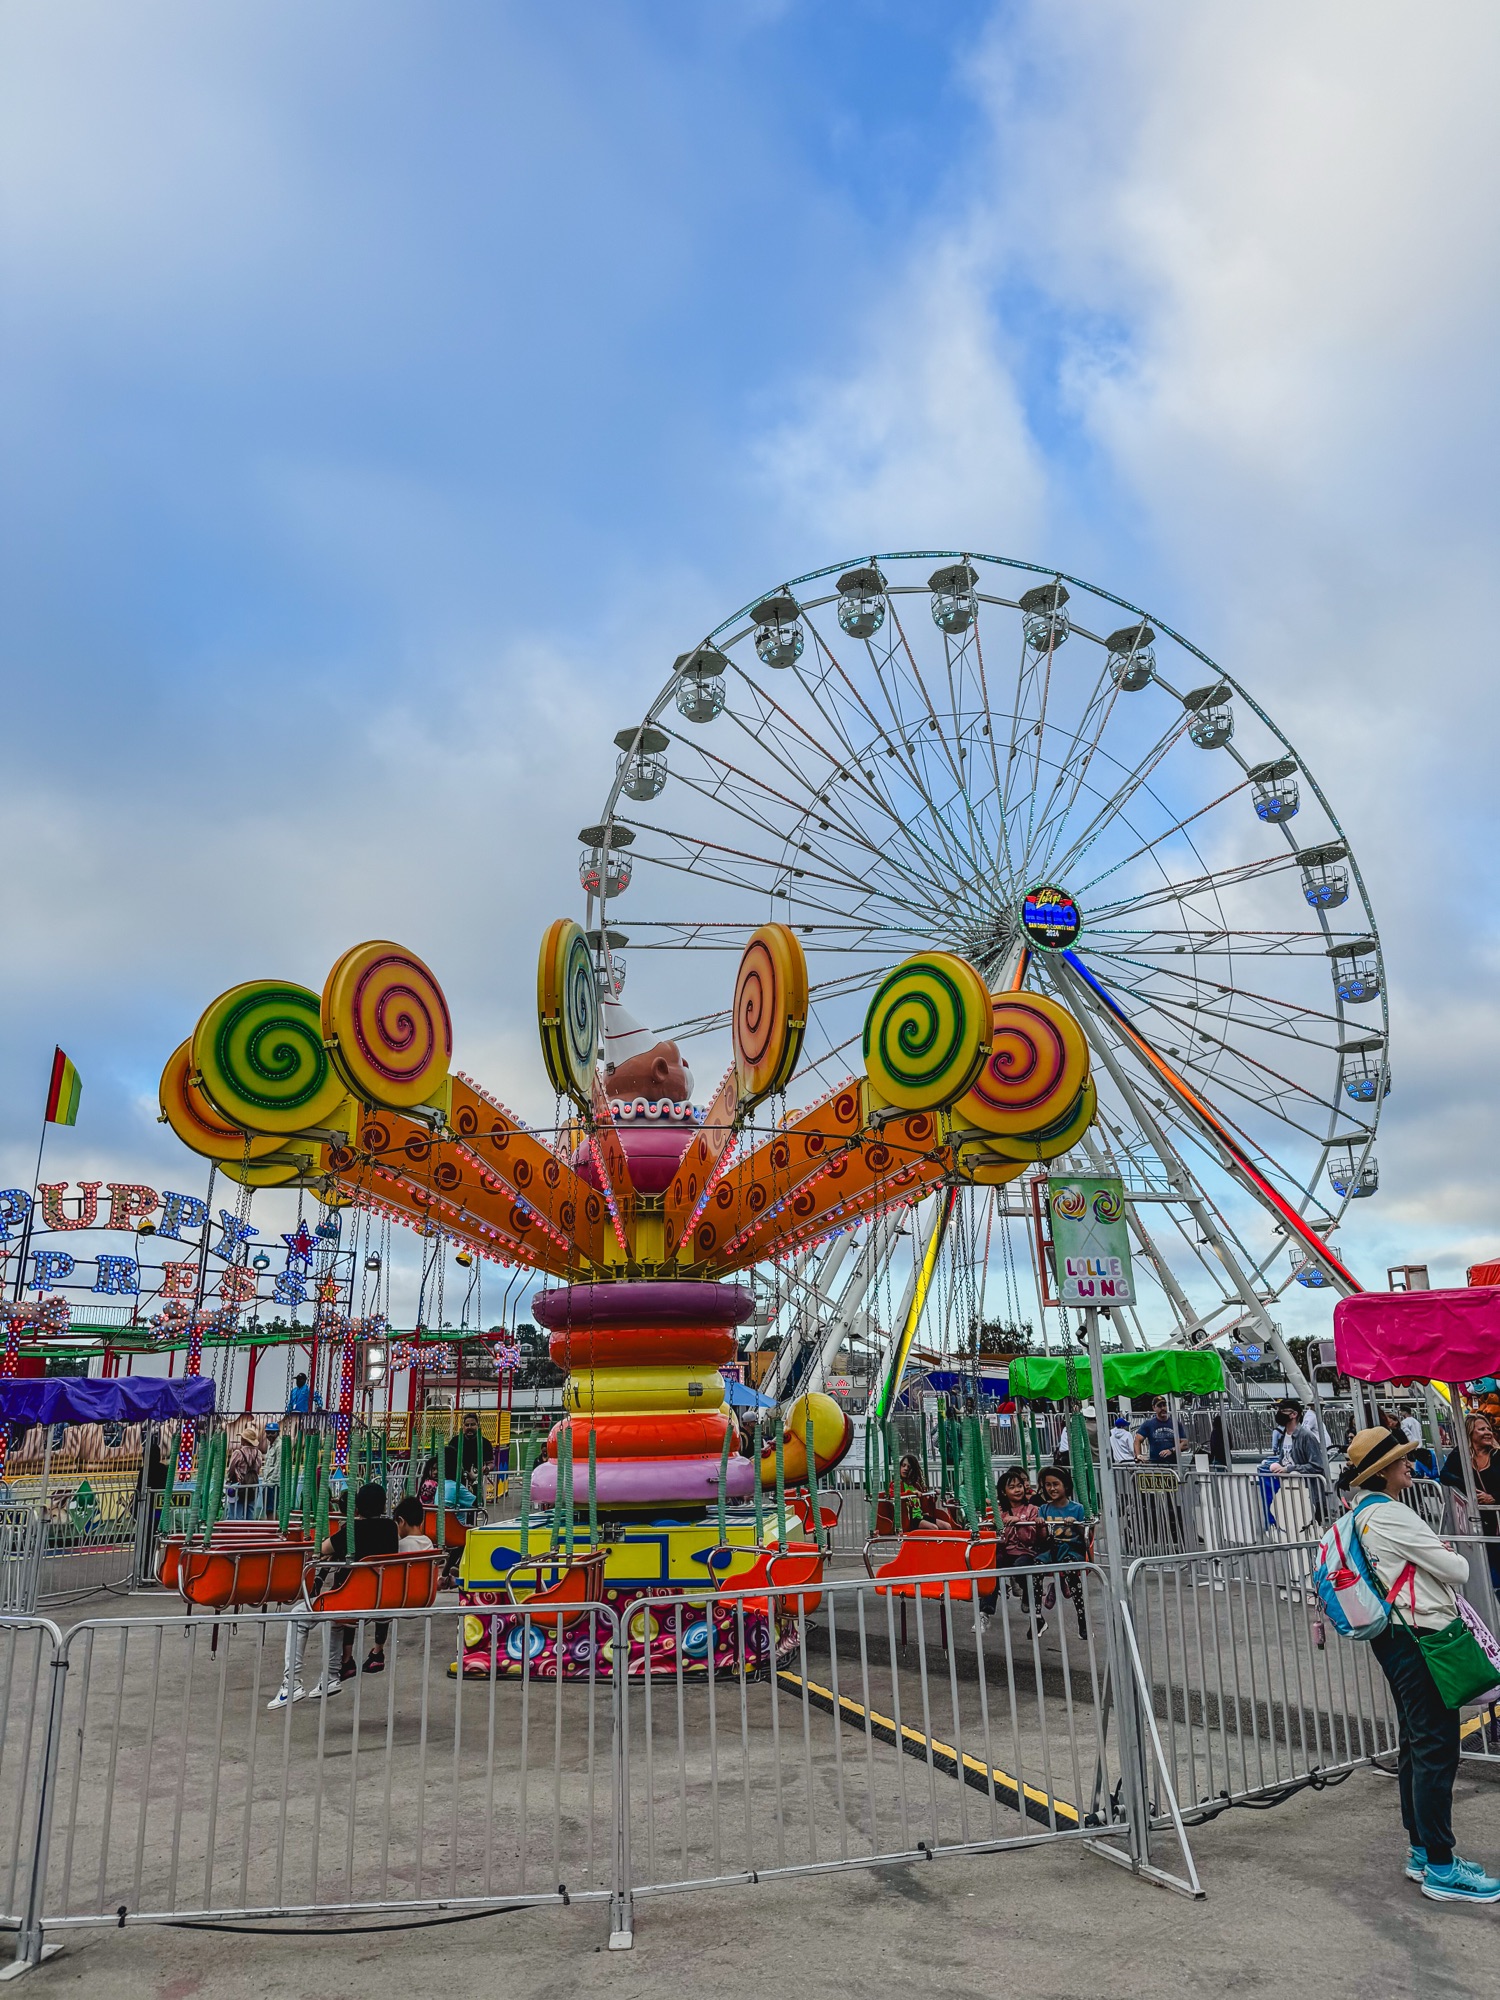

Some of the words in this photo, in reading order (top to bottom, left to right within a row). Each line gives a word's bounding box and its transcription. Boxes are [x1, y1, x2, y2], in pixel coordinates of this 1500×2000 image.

[0, 1181, 260, 1262] PUPPY
[0, 1250, 309, 1306] PRESS
[1065, 1257, 1121, 1277] LOLLIE
